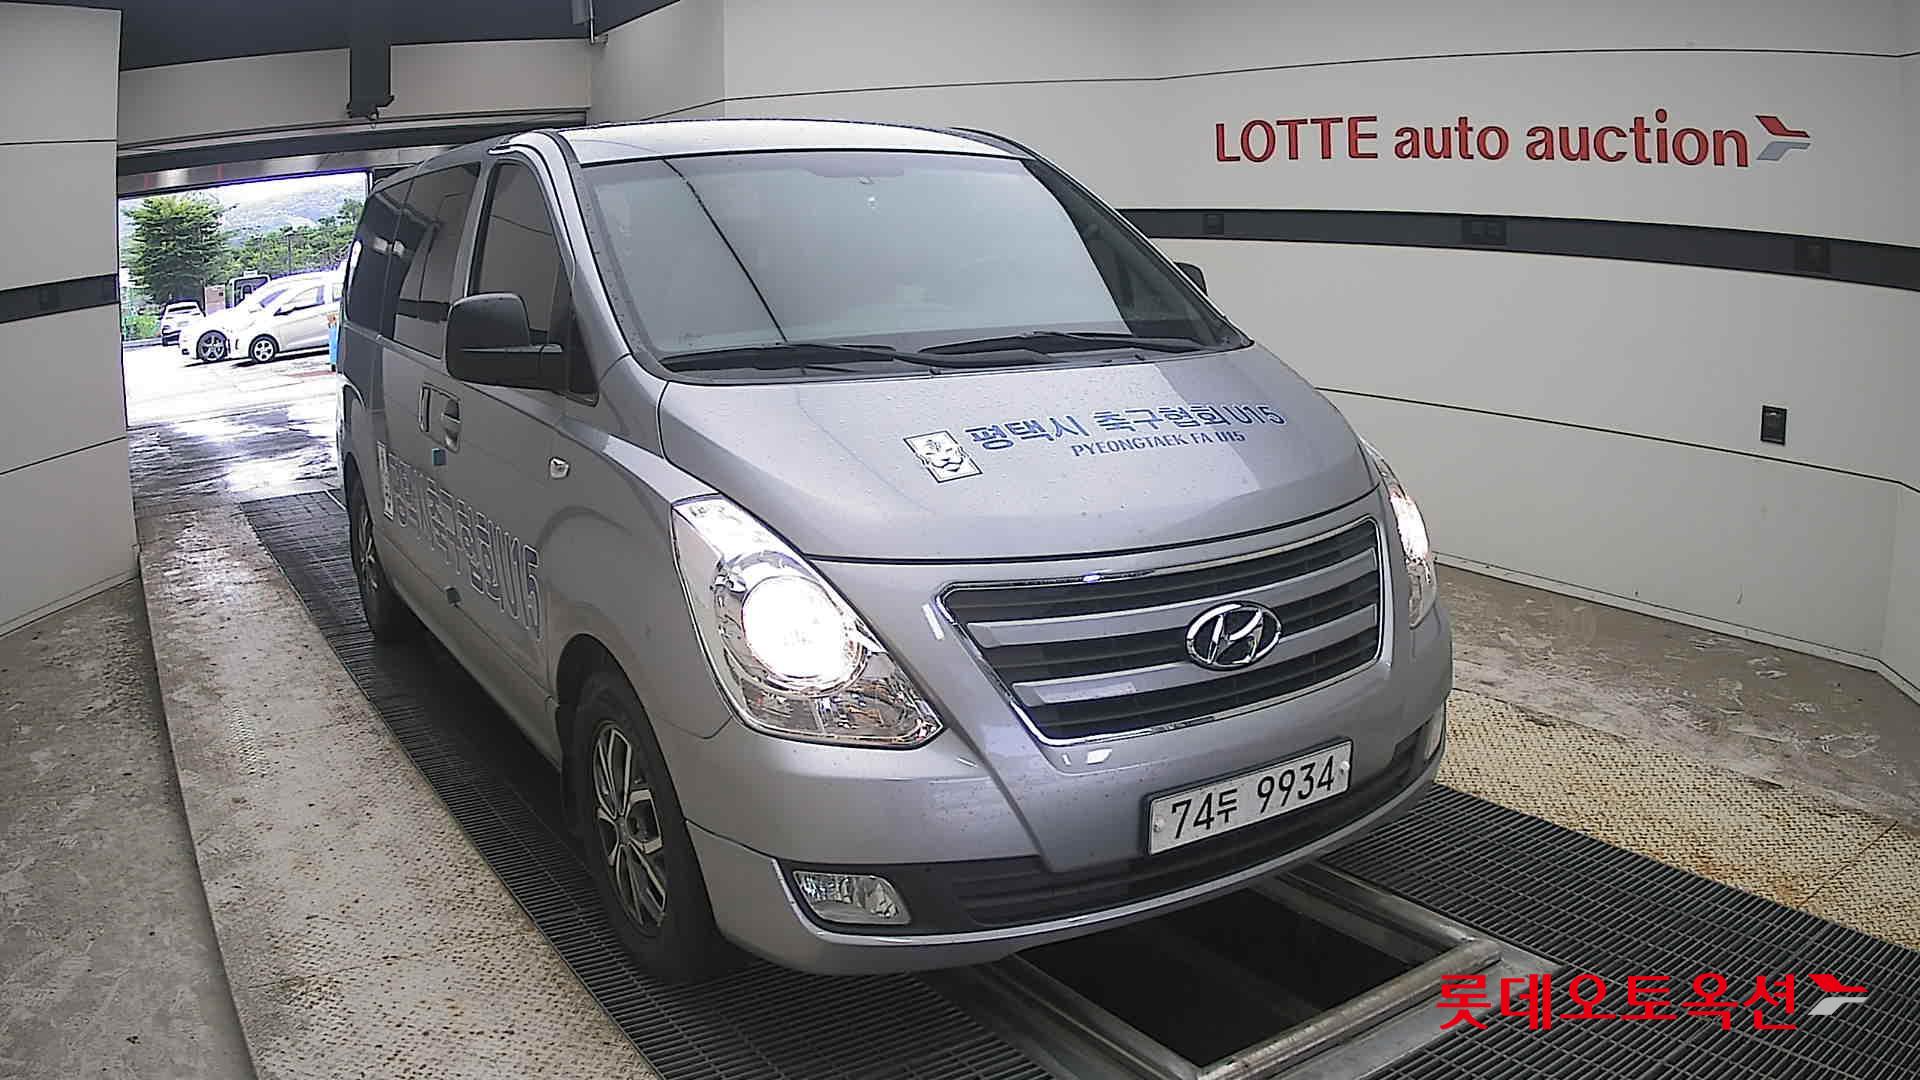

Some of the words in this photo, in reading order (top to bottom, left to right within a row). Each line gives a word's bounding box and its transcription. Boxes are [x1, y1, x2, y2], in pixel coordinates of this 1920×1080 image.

[1214, 116, 1378, 162] LOTTE
[1394, 117, 1509, 161] auto
[1524, 108, 1750, 169] auction
[965, 415, 1091, 450] 평택시
[1071, 434, 1187, 457] PYEONGTAEK
[1190, 431, 1214, 444] FA
[1215, 430, 1246, 443] U15
[1171, 788, 1238, 839] 74두
[1257, 755, 1335, 814] 9934
